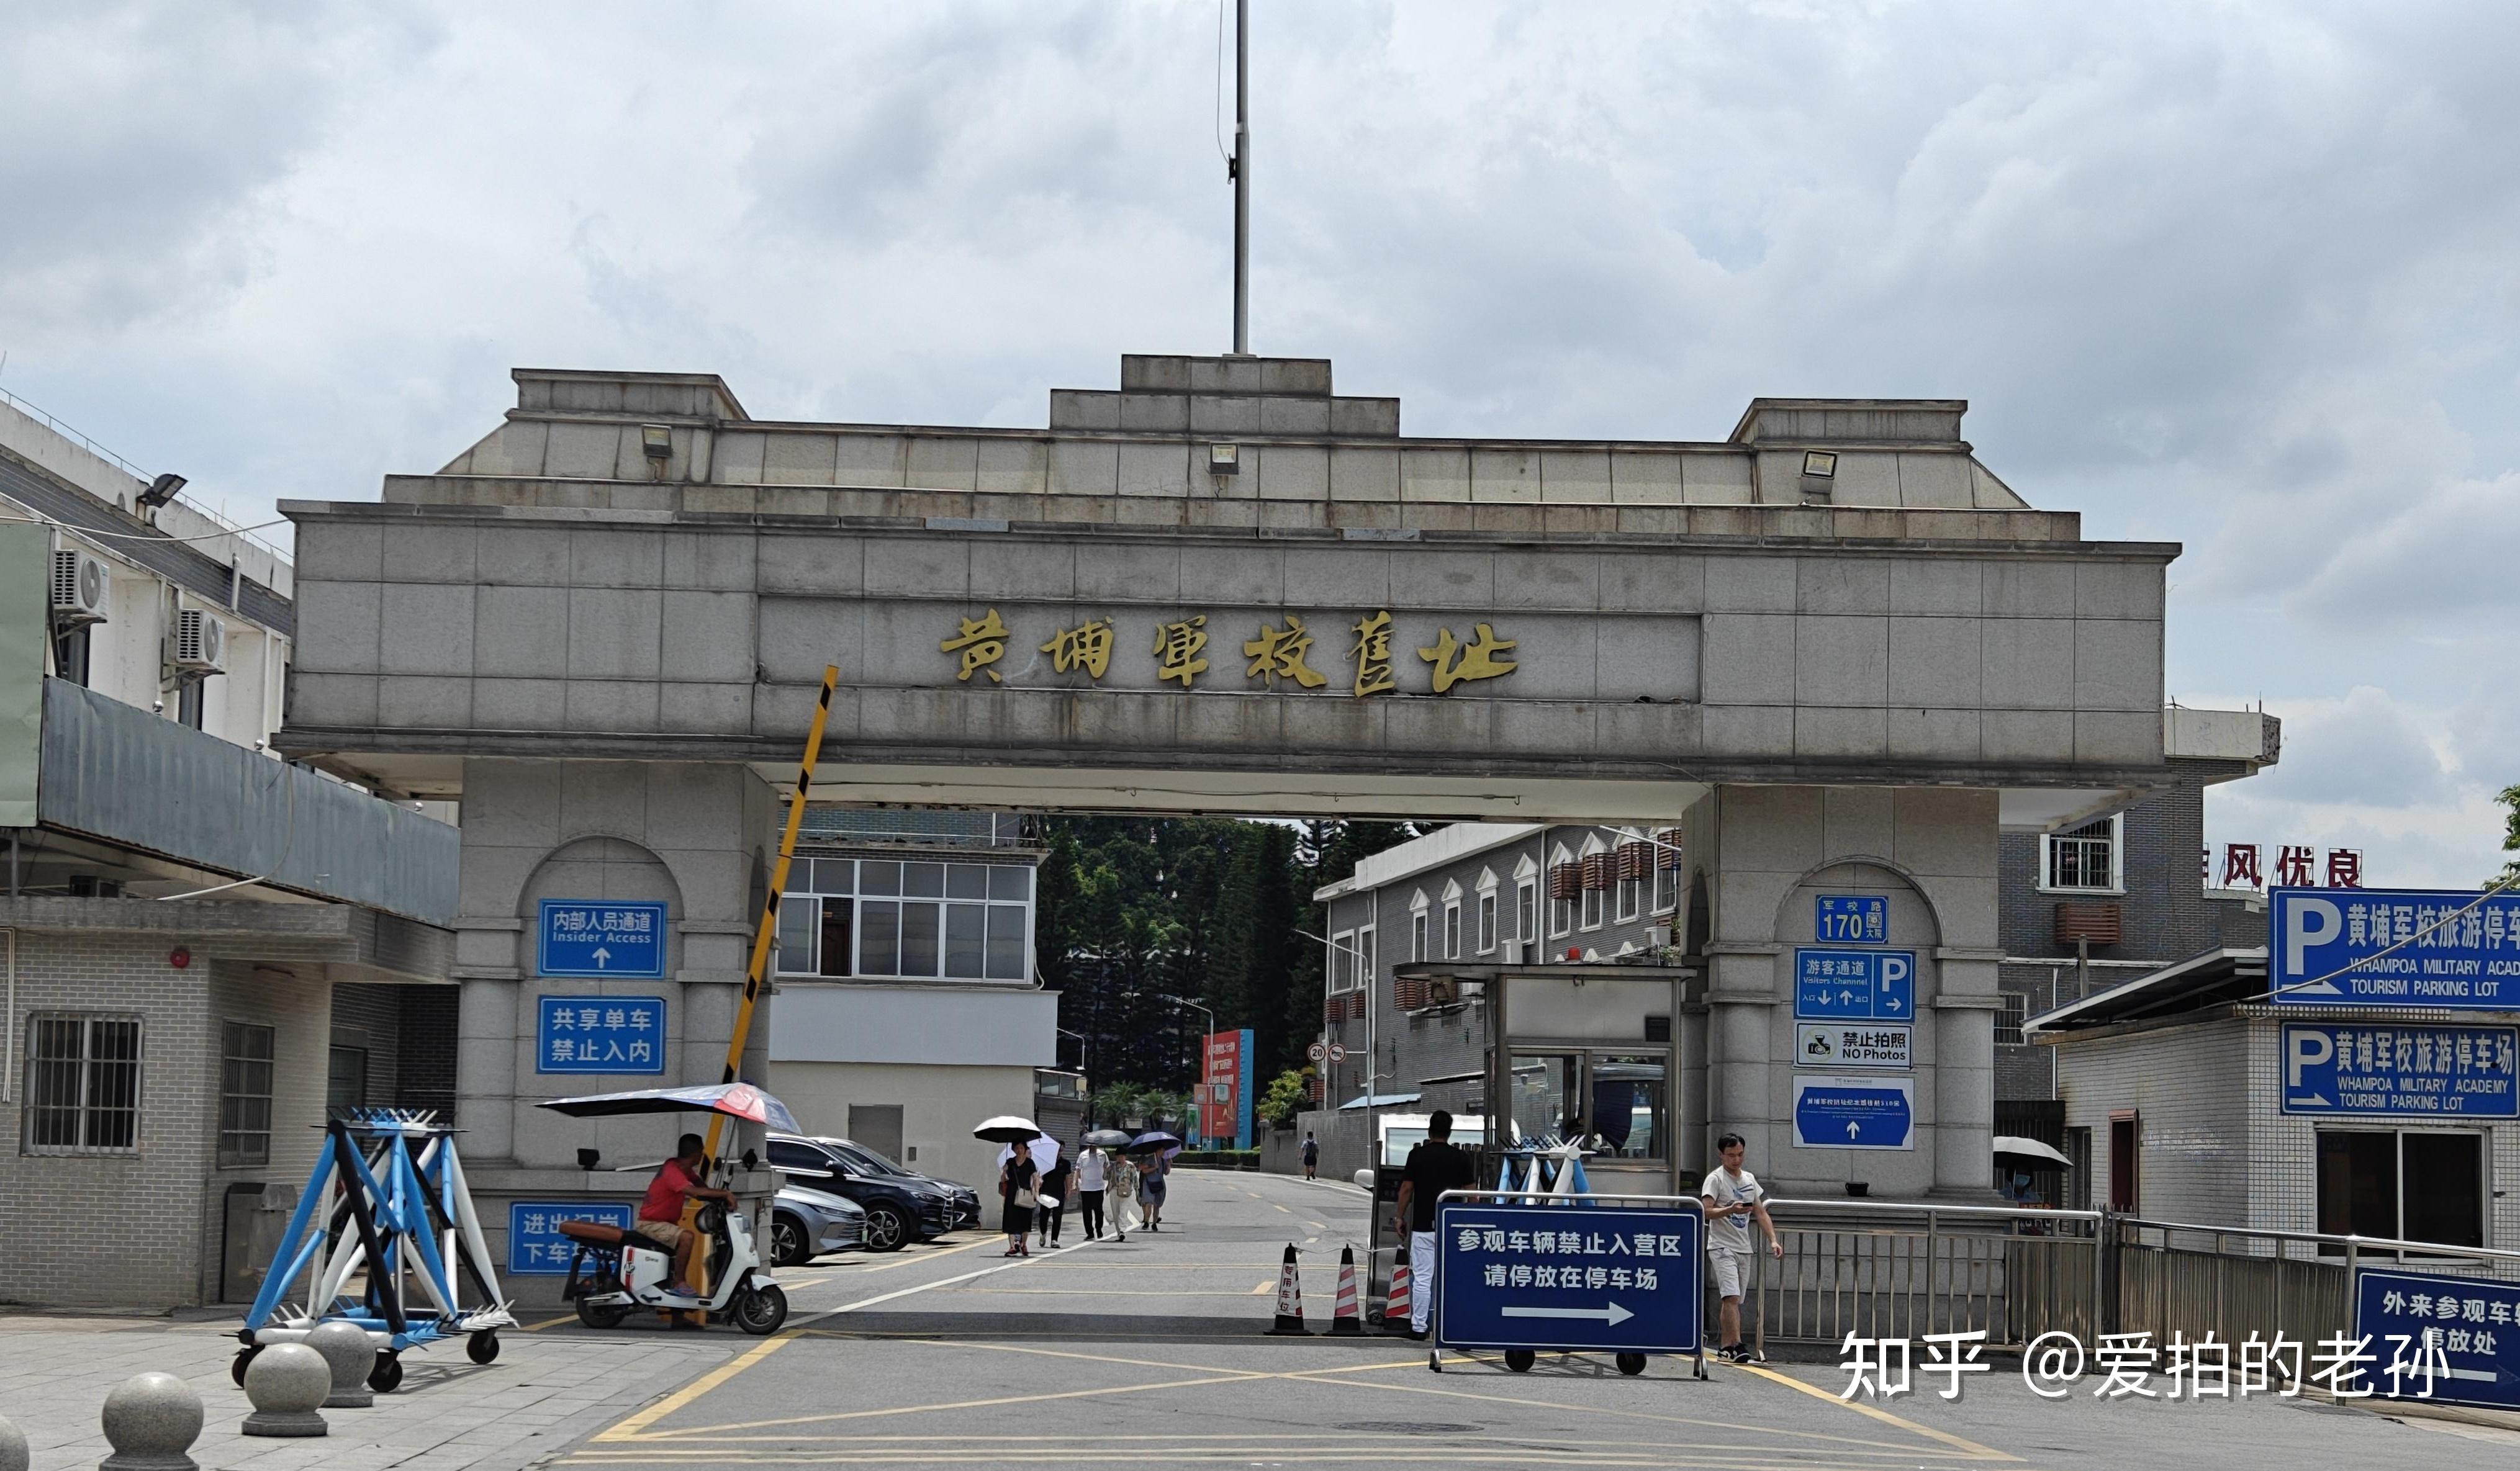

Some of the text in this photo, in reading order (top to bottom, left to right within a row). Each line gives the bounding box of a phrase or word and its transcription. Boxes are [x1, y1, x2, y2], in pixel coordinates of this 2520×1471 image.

[553, 911, 651, 932] 内部人员通道
[1823, 914, 1863, 939] 170
[553, 932, 651, 943] Insider Access
[1866, 929, 1882, 939] 大院
[2286, 897, 2342, 976] P
[1806, 959, 1866, 976] 游客通道
[1882, 958, 1908, 992] P
[2350, 957, 2419, 974] WHAMPOA
[2424, 959, 2481, 975] MILITARY
[2350, 979, 2500, 997] TOURISM PARKING LOT
[552, 1007, 652, 1032] 共享单车
[551, 1039, 651, 1063] 禁止入内
[1842, 1032, 1906, 1048] 禁止拍照
[1312, 1047, 1323, 1057] 20
[1842, 1049, 1906, 1061] NO Photos
[2289, 1030, 2334, 1087] P
[2336, 1031, 2513, 1076] 黄埔军校旅游停车场
[2337, 1076, 2509, 1094] WHAMPOA MILITARY ACADEMY
[2339, 1093, 2465, 1110] TOURISM PARKING LOT
[1458, 1229, 1682, 1257] 参观车辆禁止入营区
[1484, 1264, 1658, 1291] 请停放在停车场
[2383, 1290, 2520, 1327] 外来参观车
[2420, 1326, 2497, 1356] 停放处
